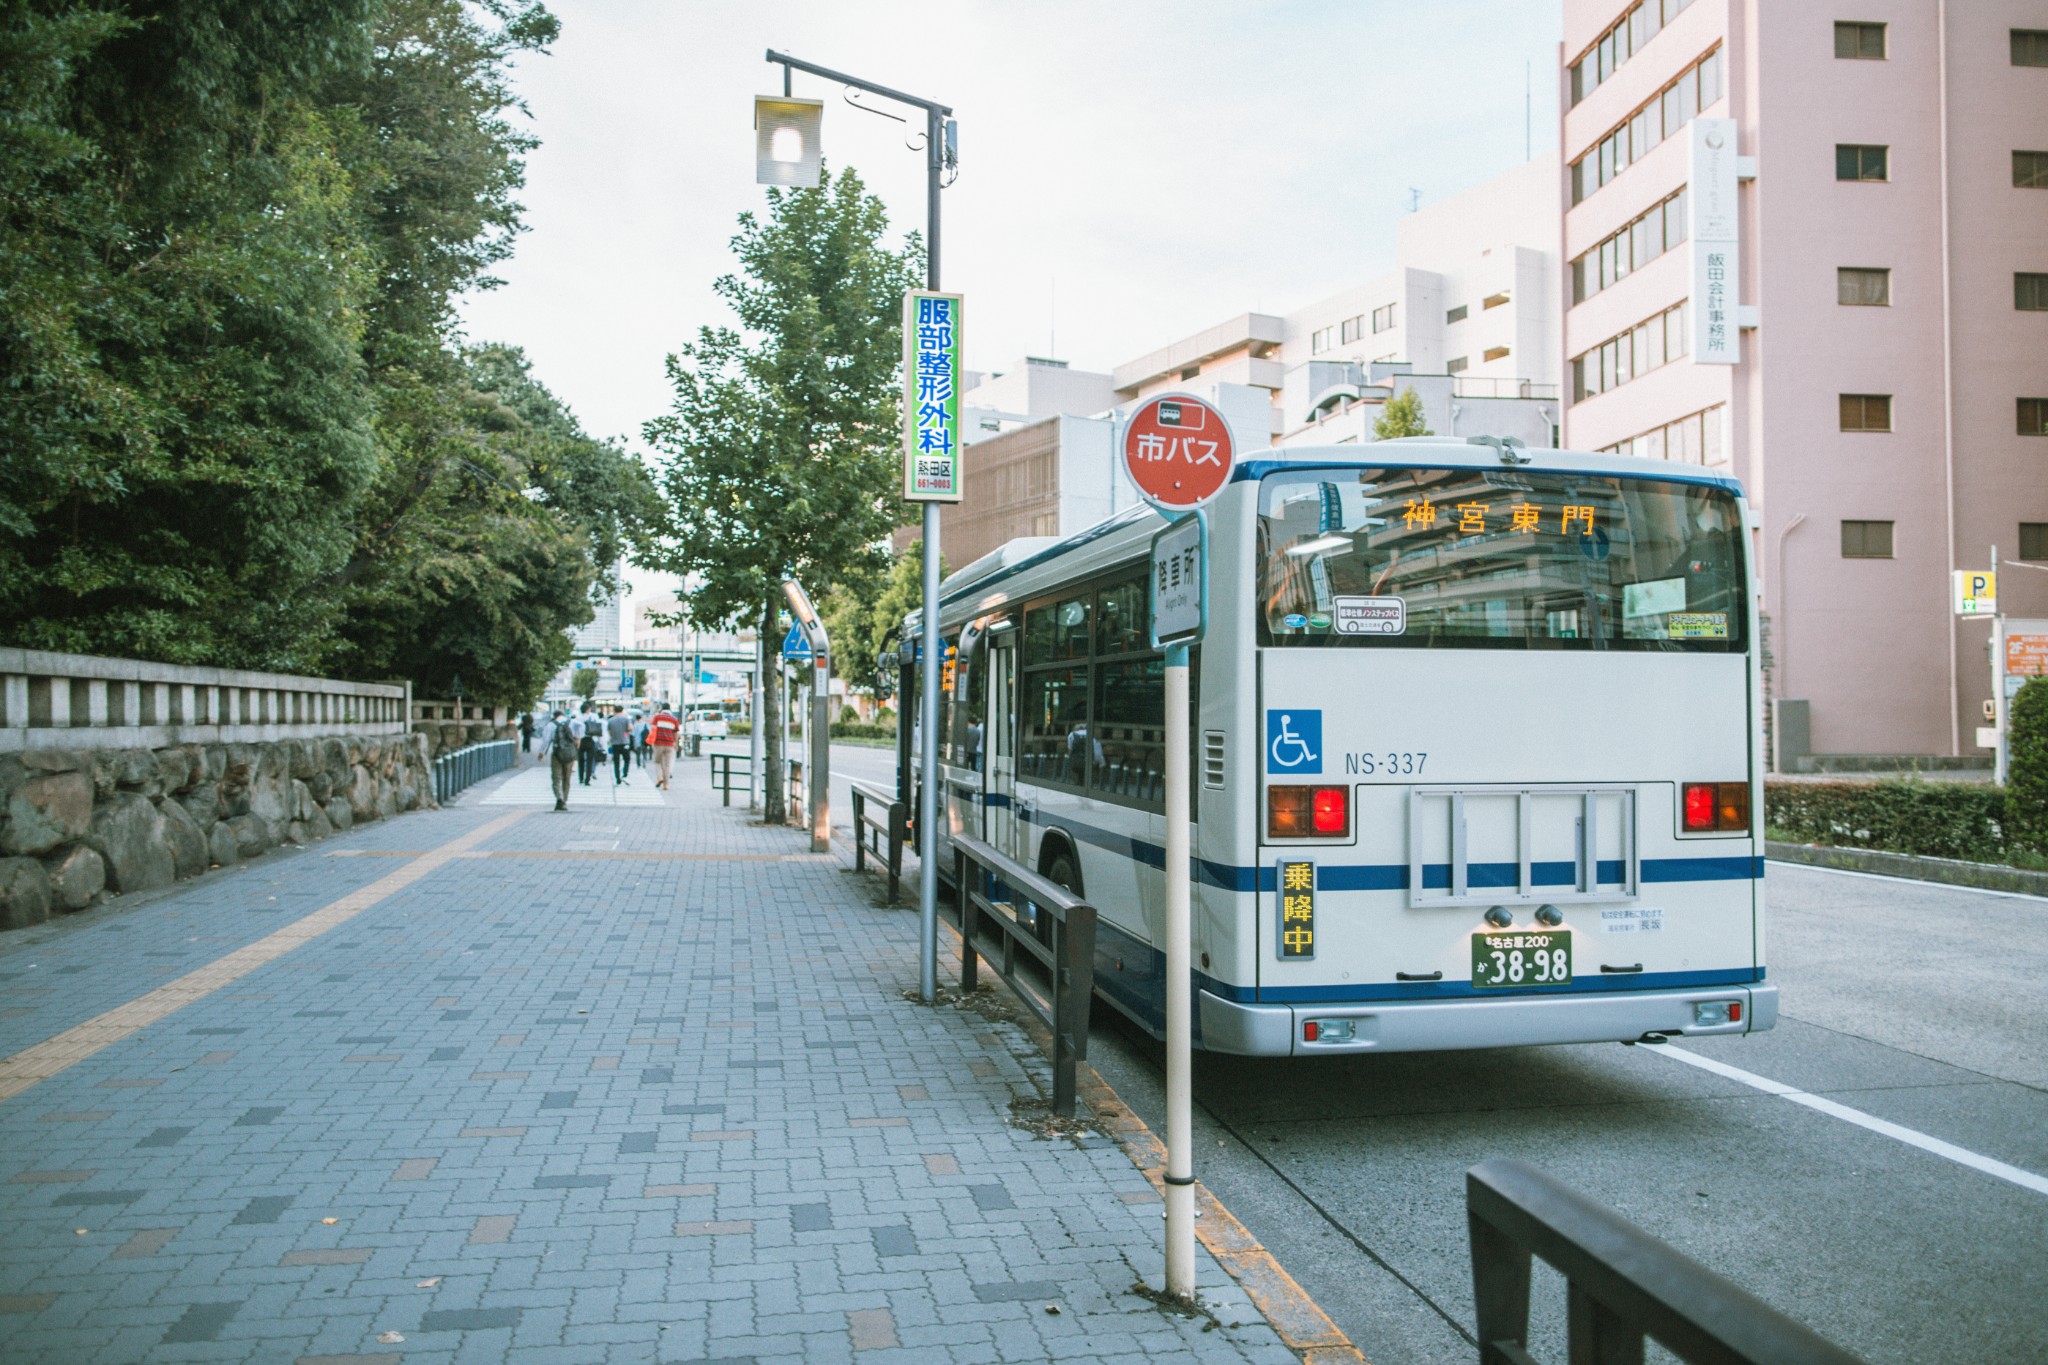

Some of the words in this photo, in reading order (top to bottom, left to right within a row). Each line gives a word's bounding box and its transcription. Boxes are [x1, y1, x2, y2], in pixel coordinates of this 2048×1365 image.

[918, 298, 953, 455] 服部整形外科
[1137, 432, 1221, 467] 市バス
[918, 461, 951, 477] 熱田区
[1402, 499, 1595, 536] 神宮東門
[1158, 545, 1195, 597] 降車所
[1973, 576, 1985, 597] P
[1346, 753, 1427, 774] NS-337
[1284, 863, 1312, 953] 乗降中
[1492, 936, 1548, 949] 名古屋200
[1477, 962, 1488, 973] か
[1490, 949, 1568, 983] 38-98
